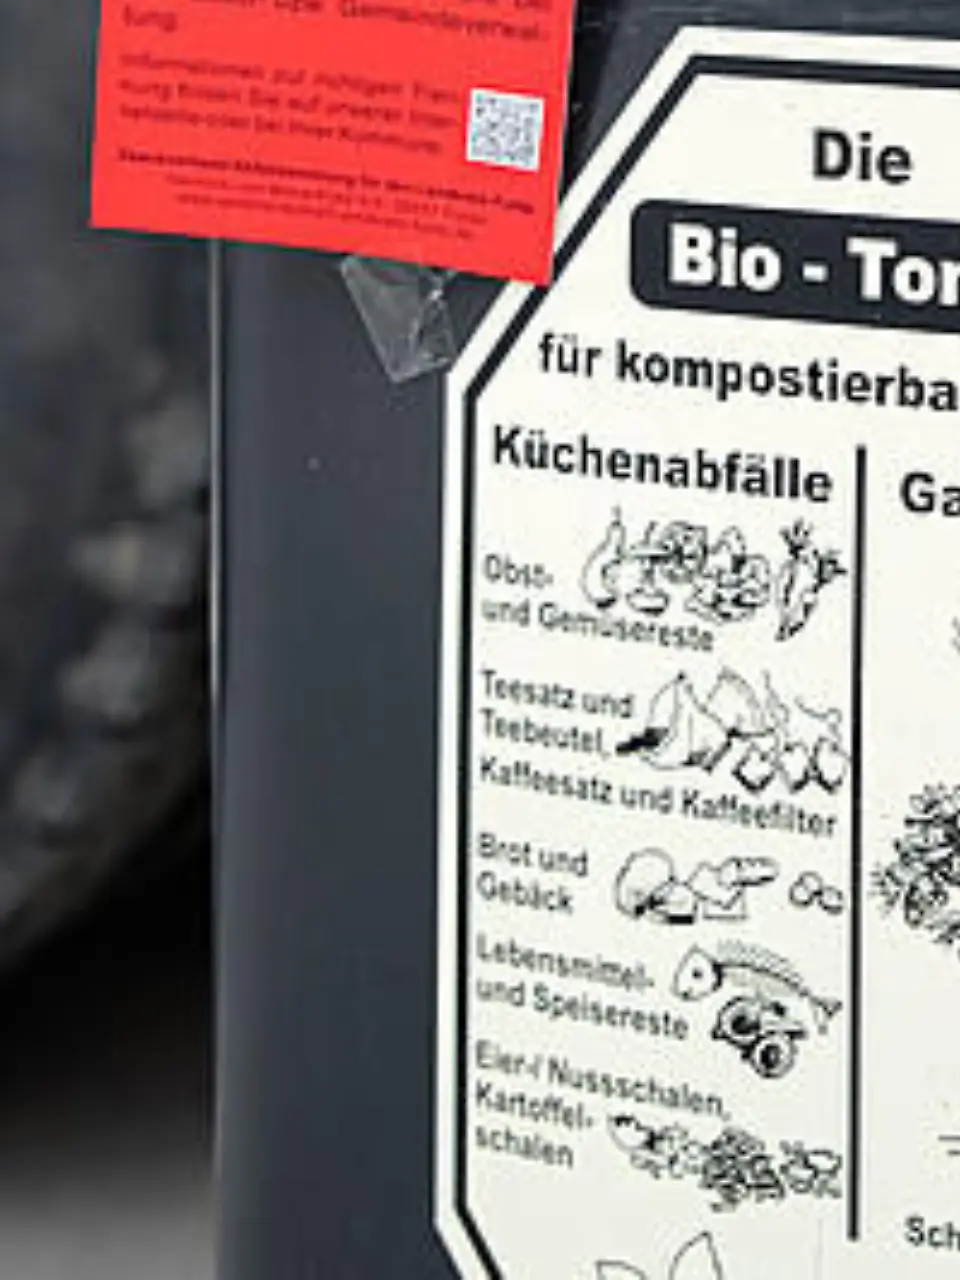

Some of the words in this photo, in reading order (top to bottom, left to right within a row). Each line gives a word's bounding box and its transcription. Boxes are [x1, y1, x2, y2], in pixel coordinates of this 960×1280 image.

[812, 128, 912, 185] Die
[668, 222, 782, 292] Bio
[538, 330, 602, 376] für
[492, 425, 833, 503] Küchenabfälle
[484, 552, 554, 590] Obst-
[481, 599, 530, 627] und
[538, 600, 715, 652] Gemüsereste
[481, 669, 574, 712] Teesatz
[582, 688, 635, 719] und
[479, 756, 613, 805] Kaffeesatz
[620, 783, 674, 814] und
[681, 788, 838, 839] Kaffeefilter
[477, 831, 531, 863] Brot
[538, 843, 589, 876] und
[476, 870, 574, 914] Gebäck
[476, 978, 525, 1008] und
[534, 984, 690, 1041] Speisereste
[475, 1081, 595, 1128] Kartoffel-
[475, 1123, 574, 1168] schalen
